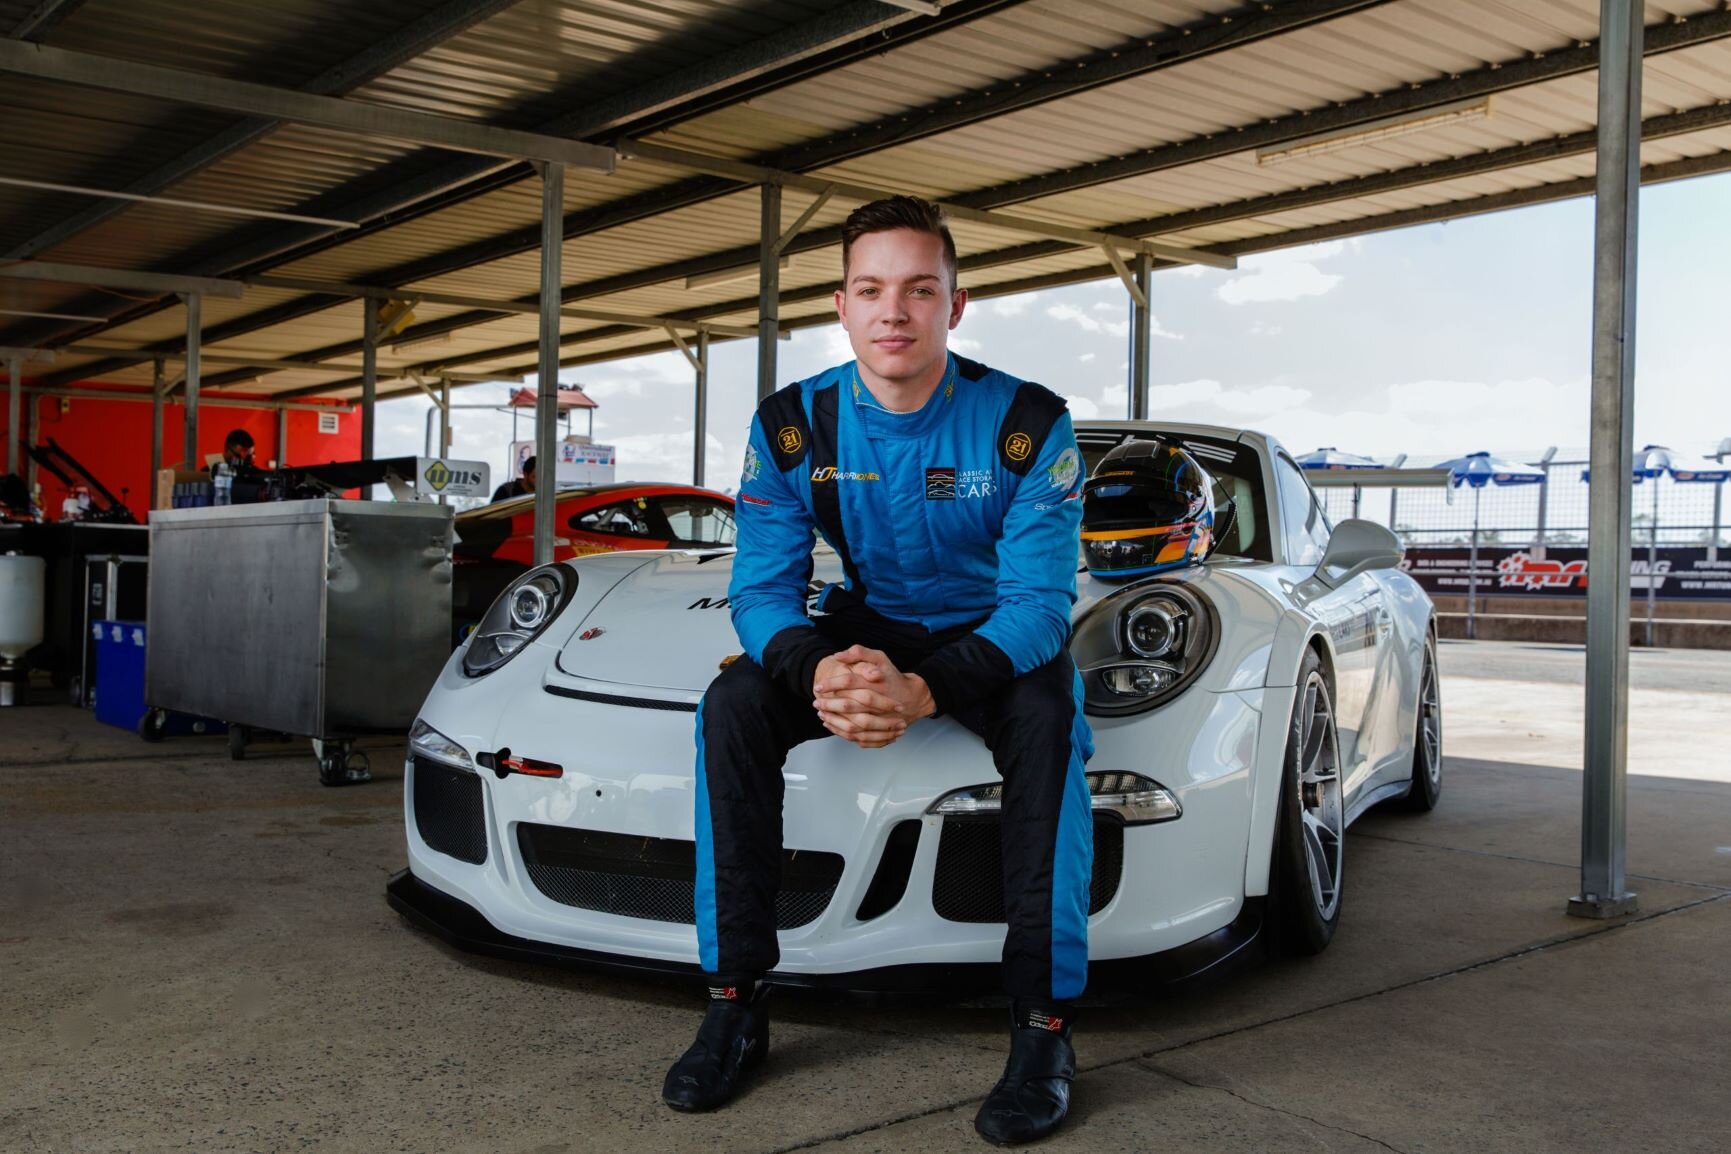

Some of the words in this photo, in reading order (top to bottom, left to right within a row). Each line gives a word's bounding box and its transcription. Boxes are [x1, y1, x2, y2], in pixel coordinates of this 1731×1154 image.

[783, 432, 798, 447] 21
[1010, 439, 1027, 454] 21
[958, 470, 983, 478] LASSIC
[958, 476, 971, 484] ACE
